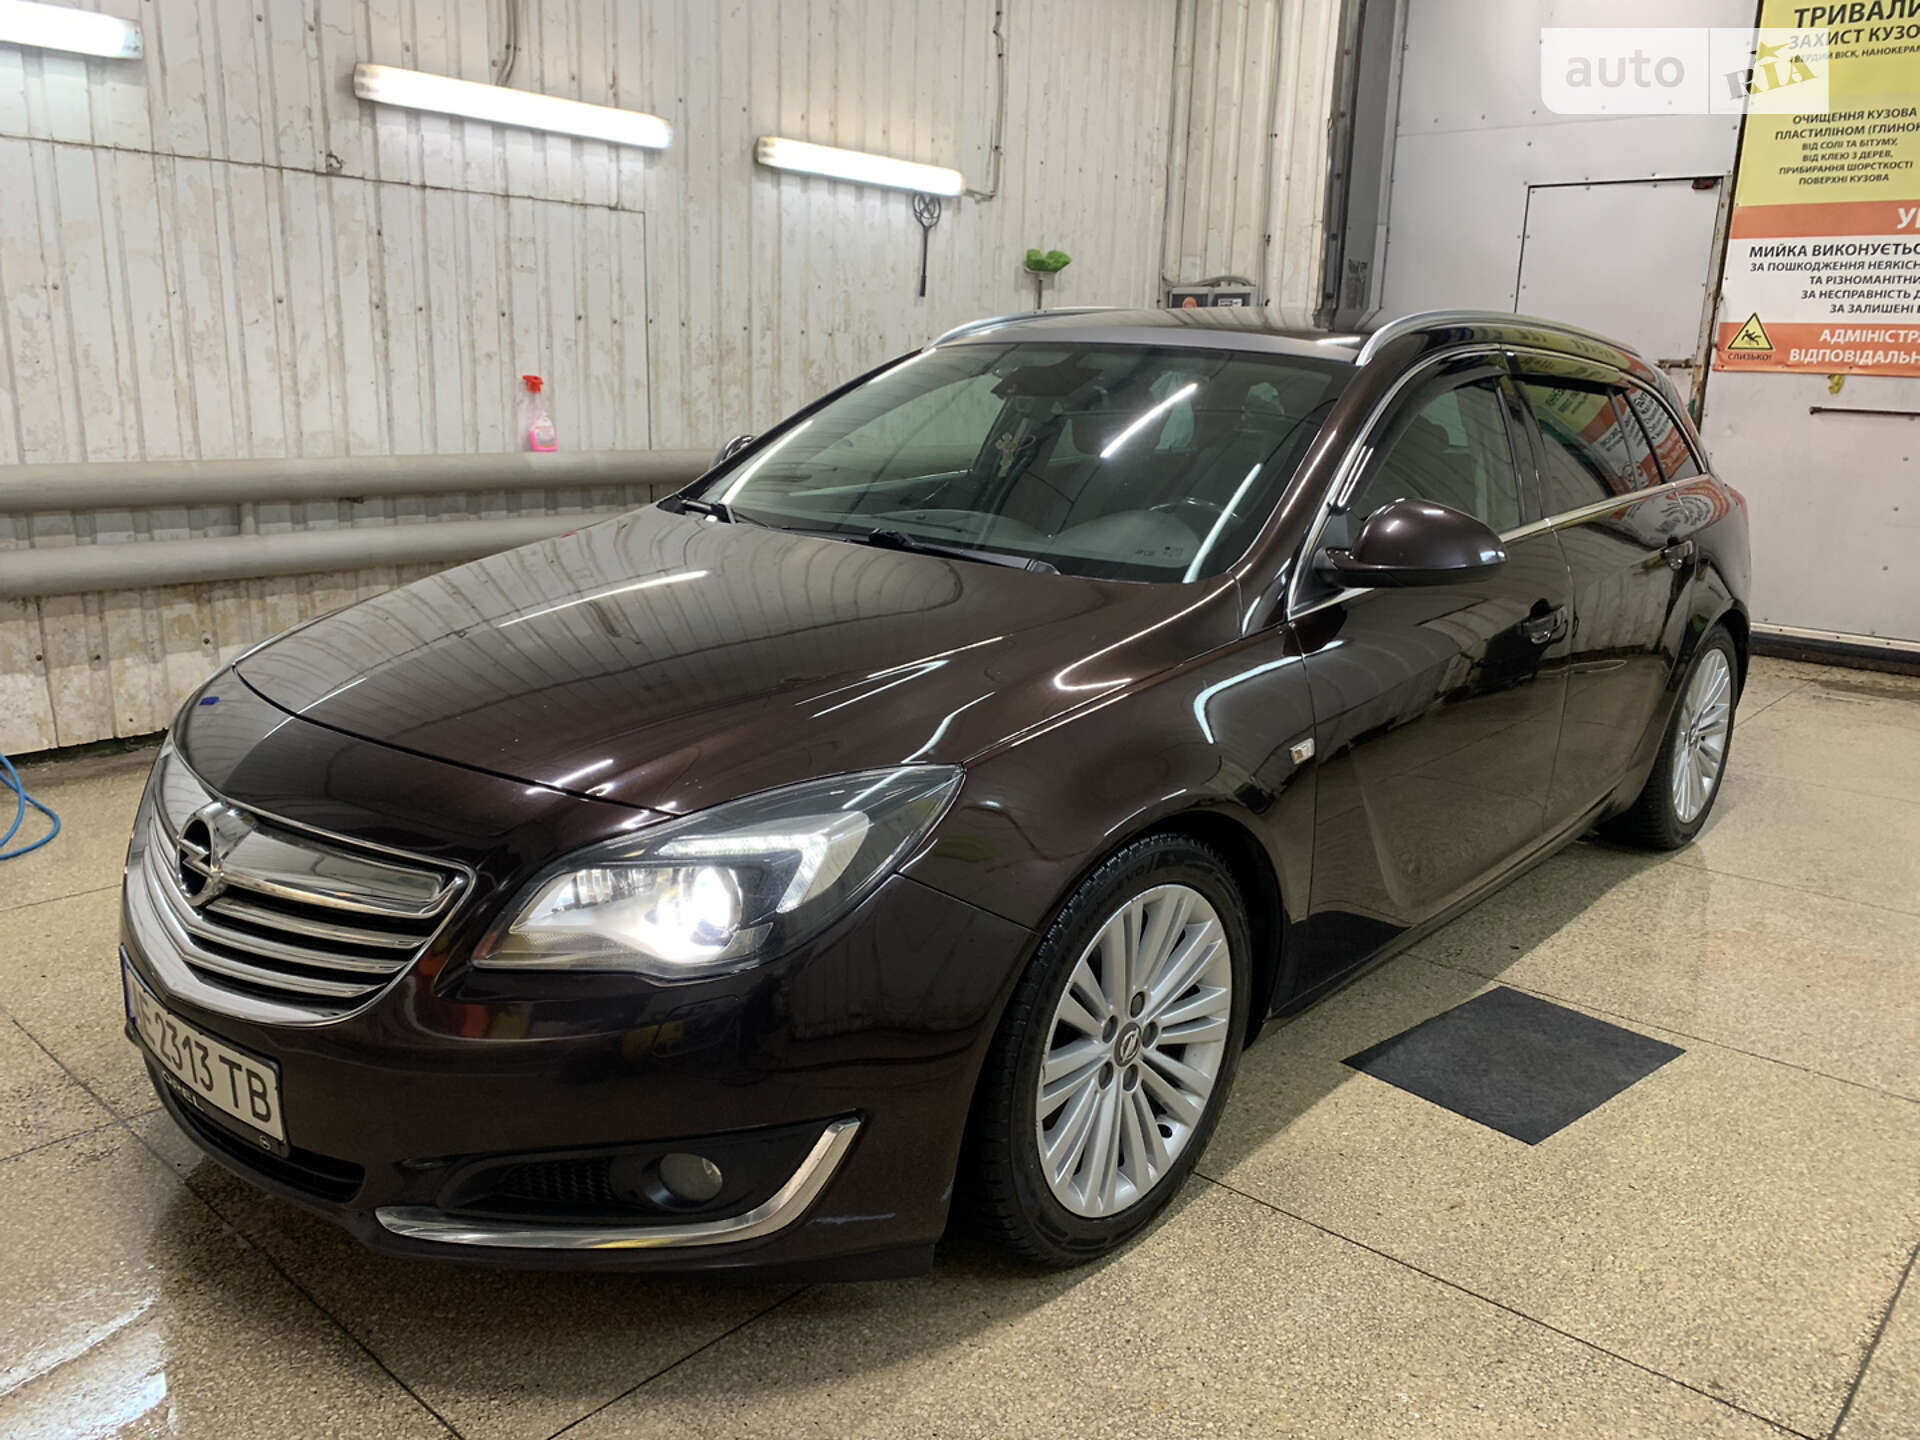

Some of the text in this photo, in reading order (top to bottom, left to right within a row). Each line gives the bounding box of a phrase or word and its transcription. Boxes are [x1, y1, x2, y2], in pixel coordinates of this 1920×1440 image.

[1788, 29, 1865, 50] ЗАХИСТ
[1793, 107, 1917, 125] ОЧИЩЕННЯ КУЗОВА
[1775, 126, 1865, 140] ПЛАСТИЛІНОМ
[1802, 142, 1819, 152] ВІД
[1820, 141, 1844, 150] СОЛІ
[1845, 140, 1857, 148] ТА
[1802, 154, 1819, 163] ВІД
[1821, 153, 1850, 162] КЛЕЮ
[1779, 160, 1913, 175] ПРИБИРАННЯ ШОРСТКОСТІ
[1798, 173, 1889, 185] ПОВЕРХНІ КУЗОВА
[1749, 243, 1807, 258] МИЙКА
[1750, 262, 1764, 272] ЗА
[1766, 261, 1865, 273] ПОШКОДЖЕННЯ
[1809, 276, 1823, 285] ТА
[1801, 290, 1816, 299] ЗА
[1818, 289, 1911, 300] НЕСПРАВНІСТЬ
[1829, 304, 1845, 314] ЗА
[1847, 303, 1914, 314] ЗАЛИШЕНІ
[1819, 329, 1920, 344] АДМІНІСТР
[156, 1012, 214, 1092] 2313
[219, 1055, 272, 1123] TB
